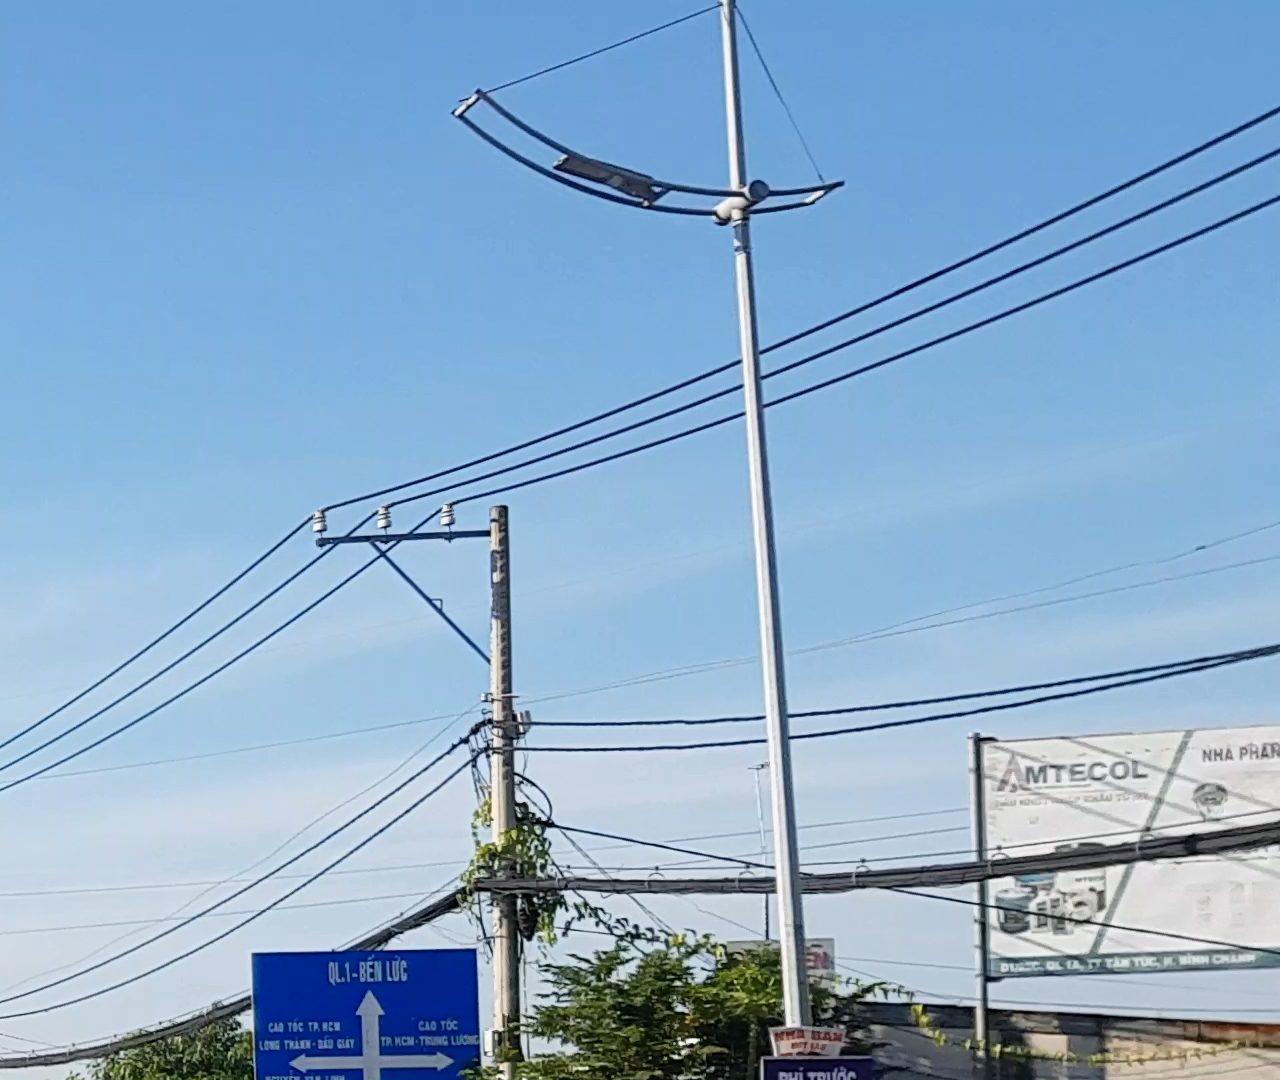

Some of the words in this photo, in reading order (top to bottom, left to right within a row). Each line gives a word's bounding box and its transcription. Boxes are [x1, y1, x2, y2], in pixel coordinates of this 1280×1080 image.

[268, 1022, 284, 1033] CAO
[418, 1020, 436, 1031] CAO
[440, 1017, 458, 1031] TỐC
